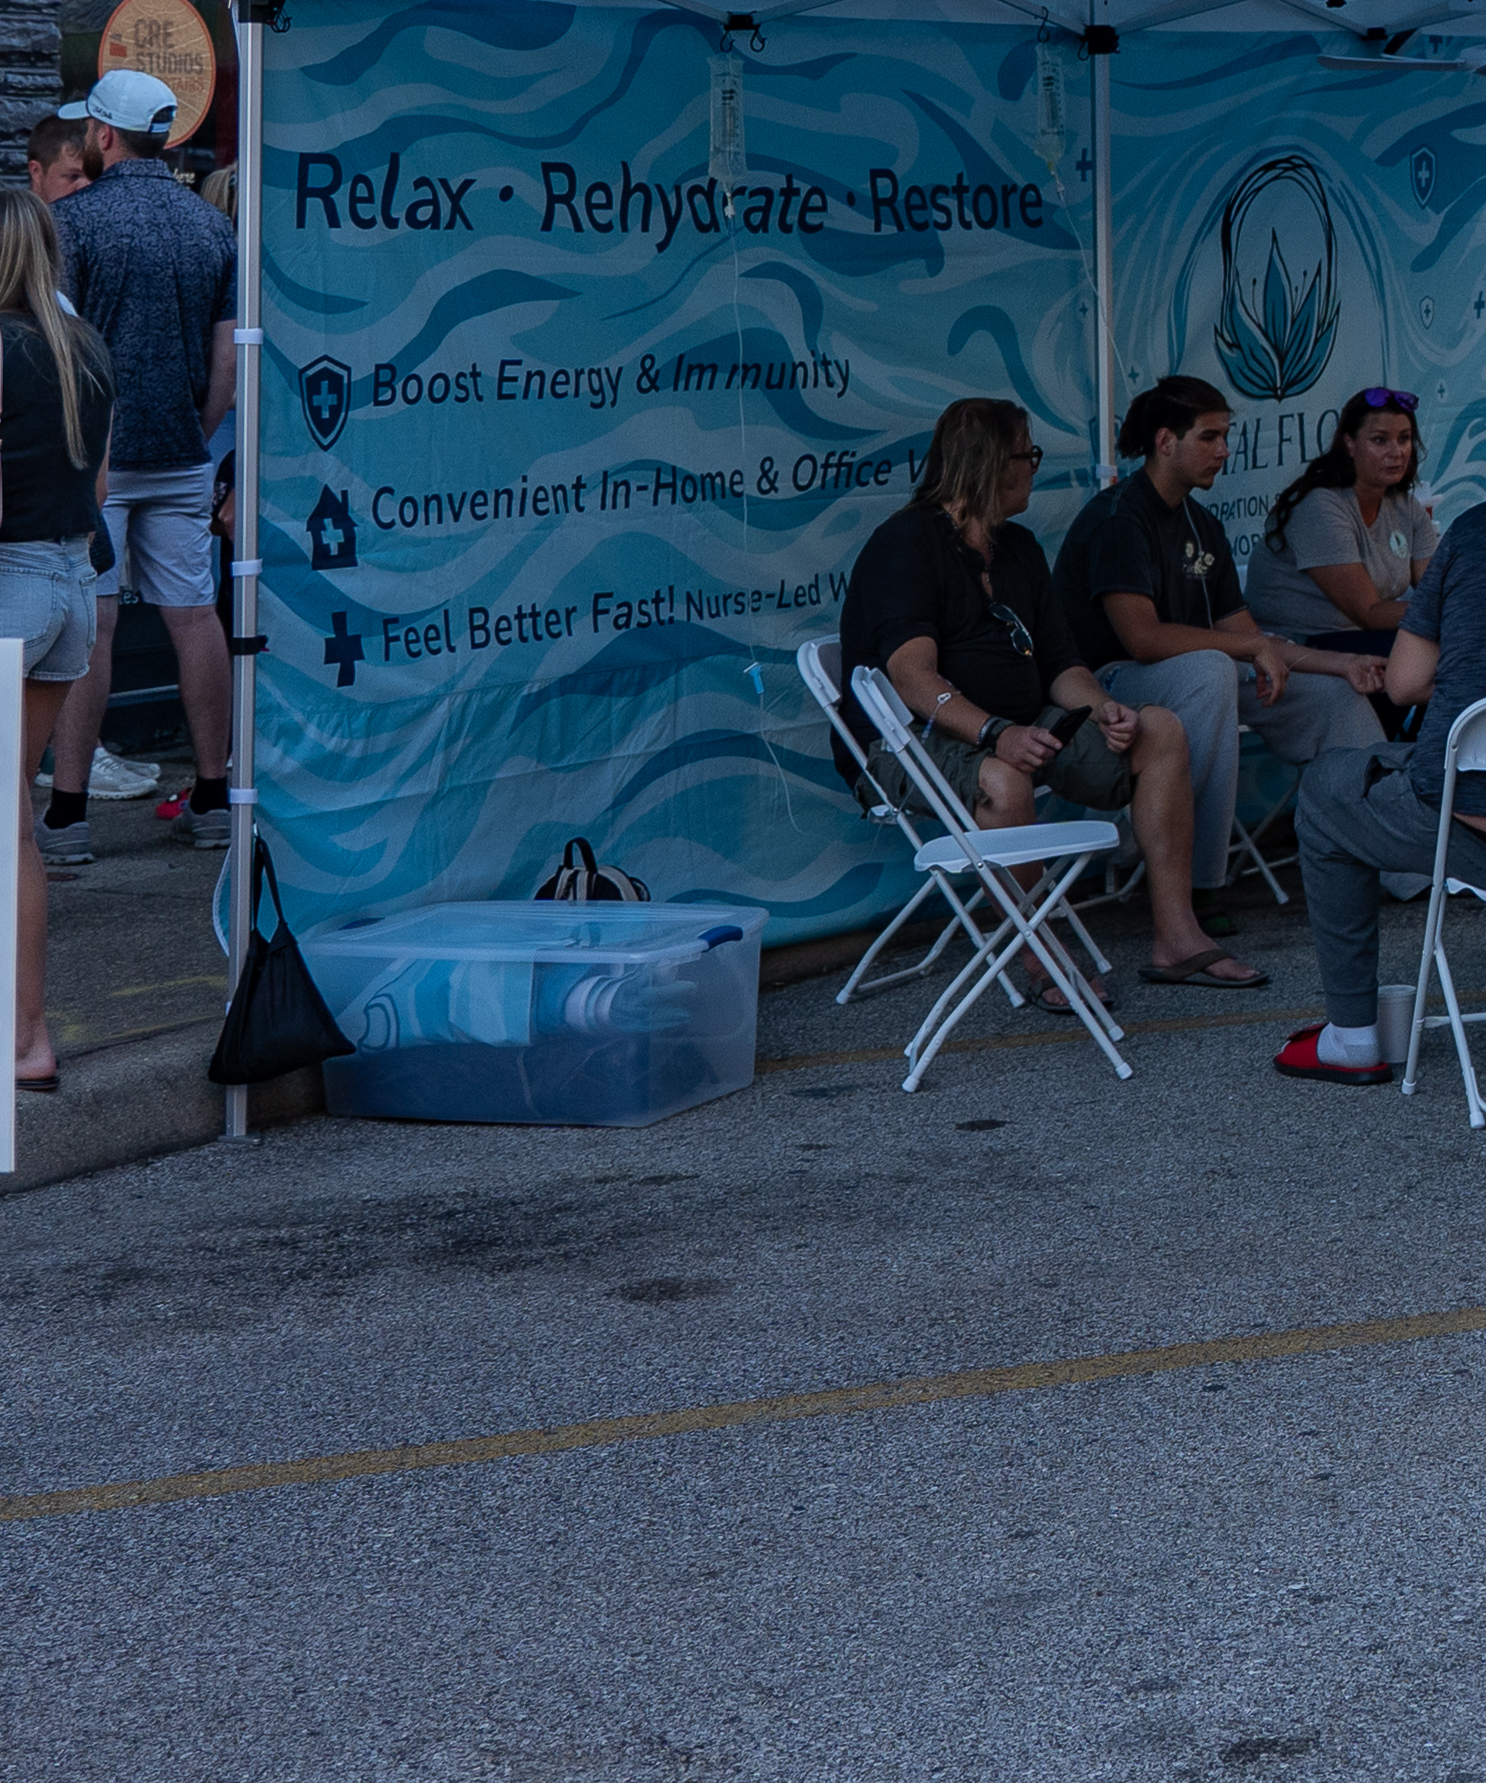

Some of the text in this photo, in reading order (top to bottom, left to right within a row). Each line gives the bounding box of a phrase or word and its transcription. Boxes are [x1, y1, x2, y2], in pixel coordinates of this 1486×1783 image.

[135, 51, 204, 76] STUDIOS
[295, 151, 1044, 254] Relax Rehydrate Restore
[372, 360, 484, 408] Boost
[497, 356, 624, 410] Energy
[636, 353, 661, 393] &
[1277, 408, 1340, 467] FLO
[372, 473, 587, 531] Convenient
[600, 463, 745, 512] In-Home
[756, 456, 779, 493] &
[792, 450, 893, 493] Office
[1207, 494, 1269, 522] DRATION
[383, 613, 457, 663] Feel
[469, 599, 578, 650] Better
[590, 584, 676, 633] Fast!
[685, 579, 823, 624] Nurse-Led
